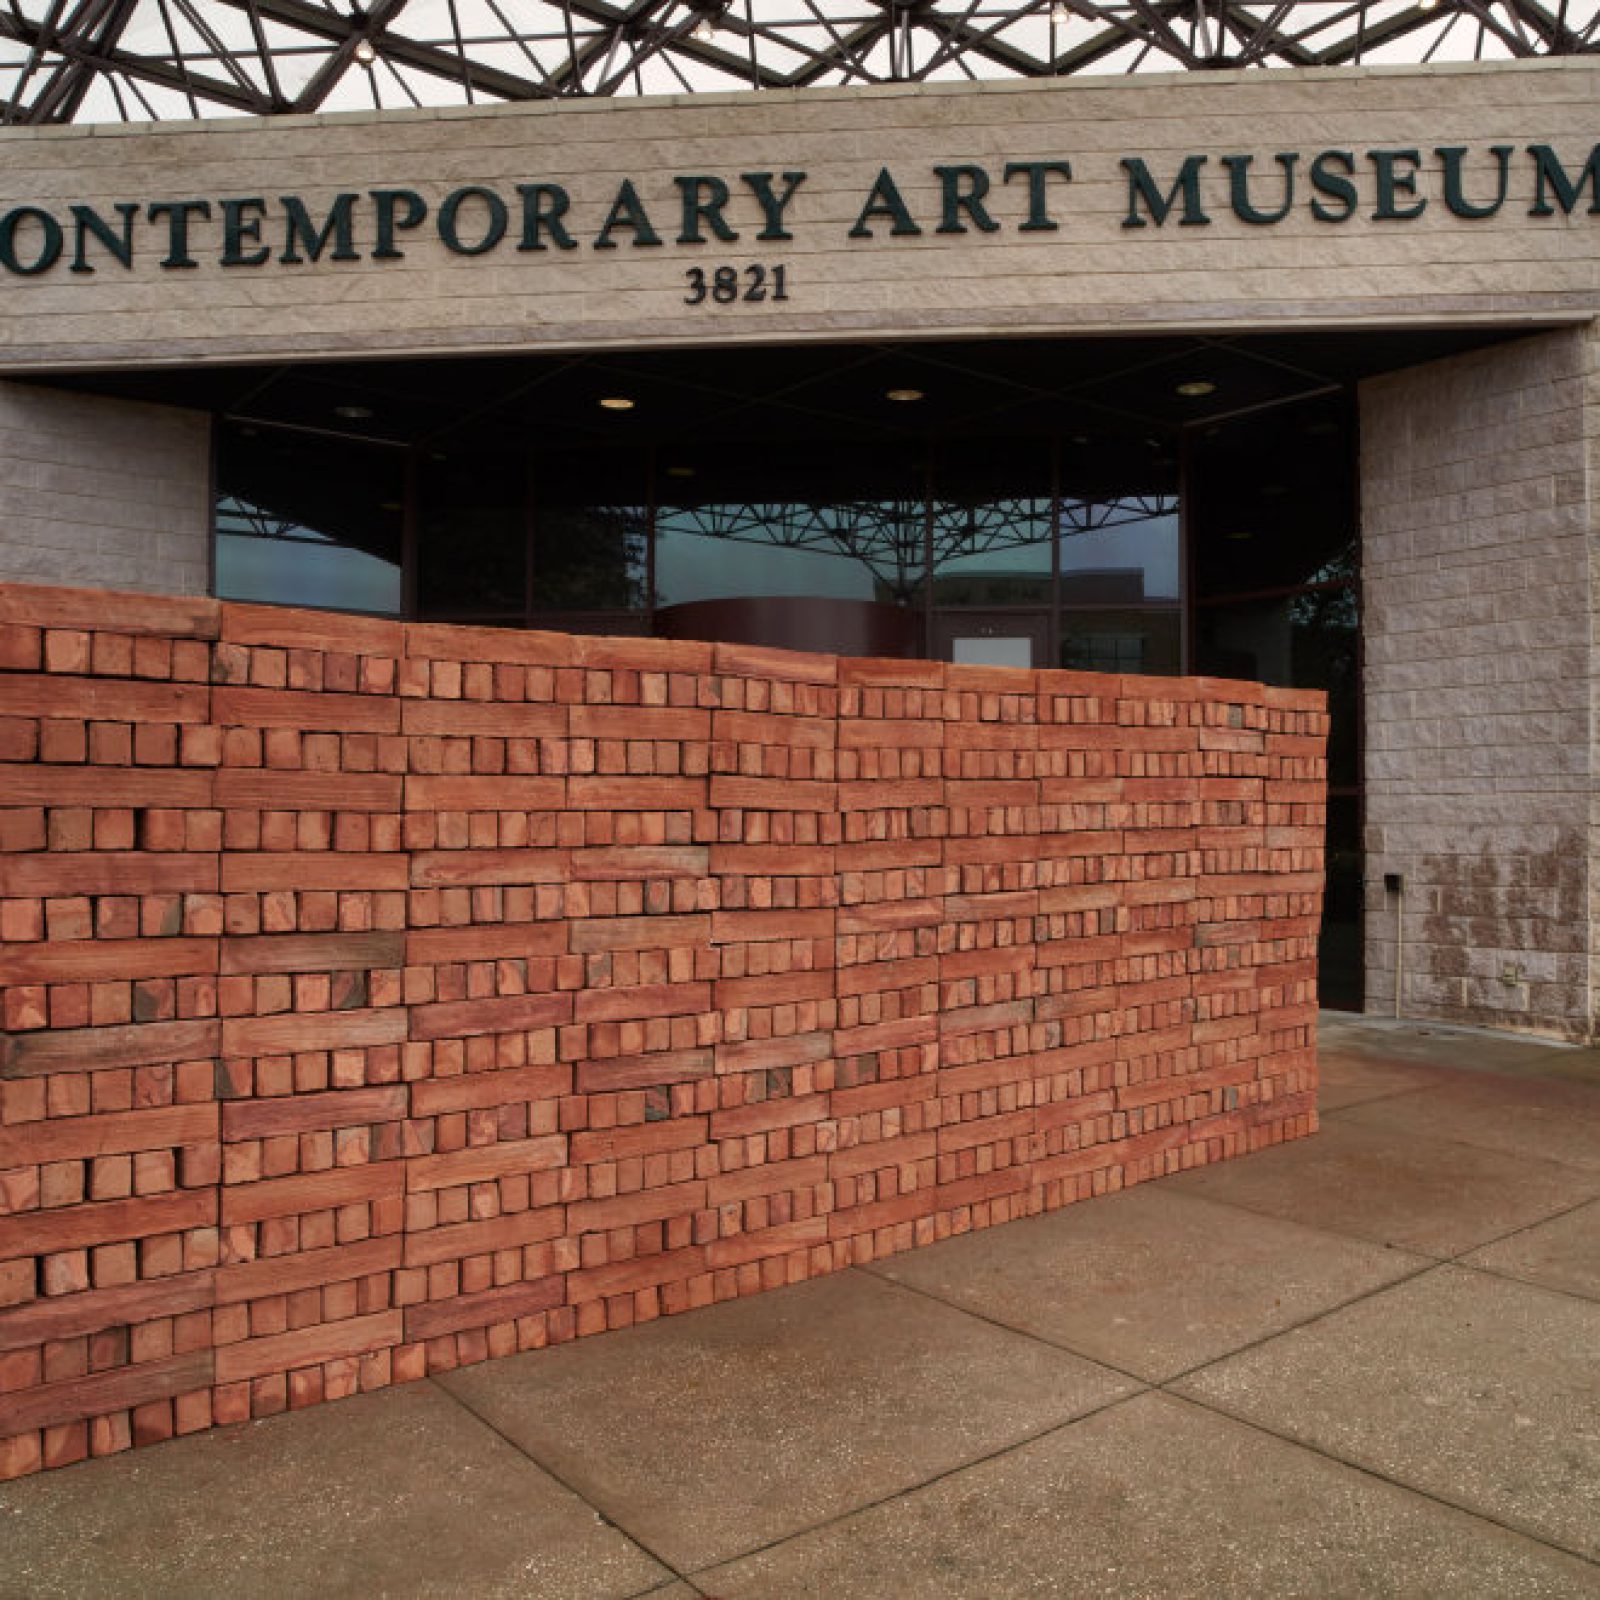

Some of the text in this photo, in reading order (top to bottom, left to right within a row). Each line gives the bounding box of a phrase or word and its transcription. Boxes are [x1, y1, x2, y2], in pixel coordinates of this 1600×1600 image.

[0, 143, 1600, 275] ONTEMPORARY ART MUSEUM
[684, 263, 789, 305] 3821
